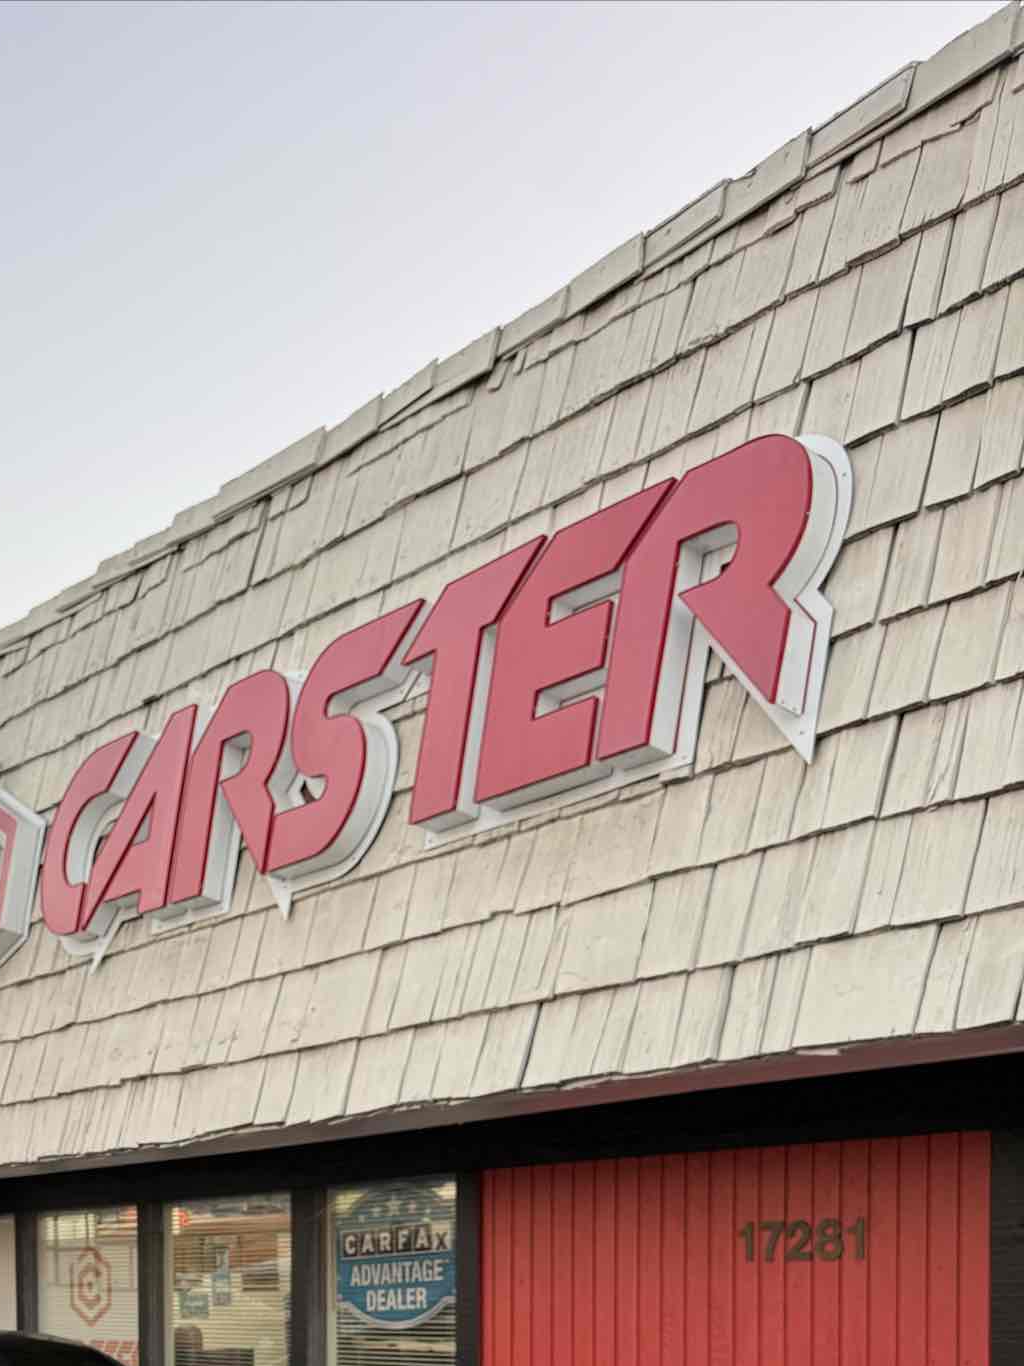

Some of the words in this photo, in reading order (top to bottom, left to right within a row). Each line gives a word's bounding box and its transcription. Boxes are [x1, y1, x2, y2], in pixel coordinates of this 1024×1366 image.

[40, 432, 836, 945] CARSTER
[343, 1226, 449, 1256] CARFAX
[740, 1216, 865, 1264] 17281
[350, 1261, 444, 1287] ADVANTAGE
[366, 1287, 428, 1312] DEALER
